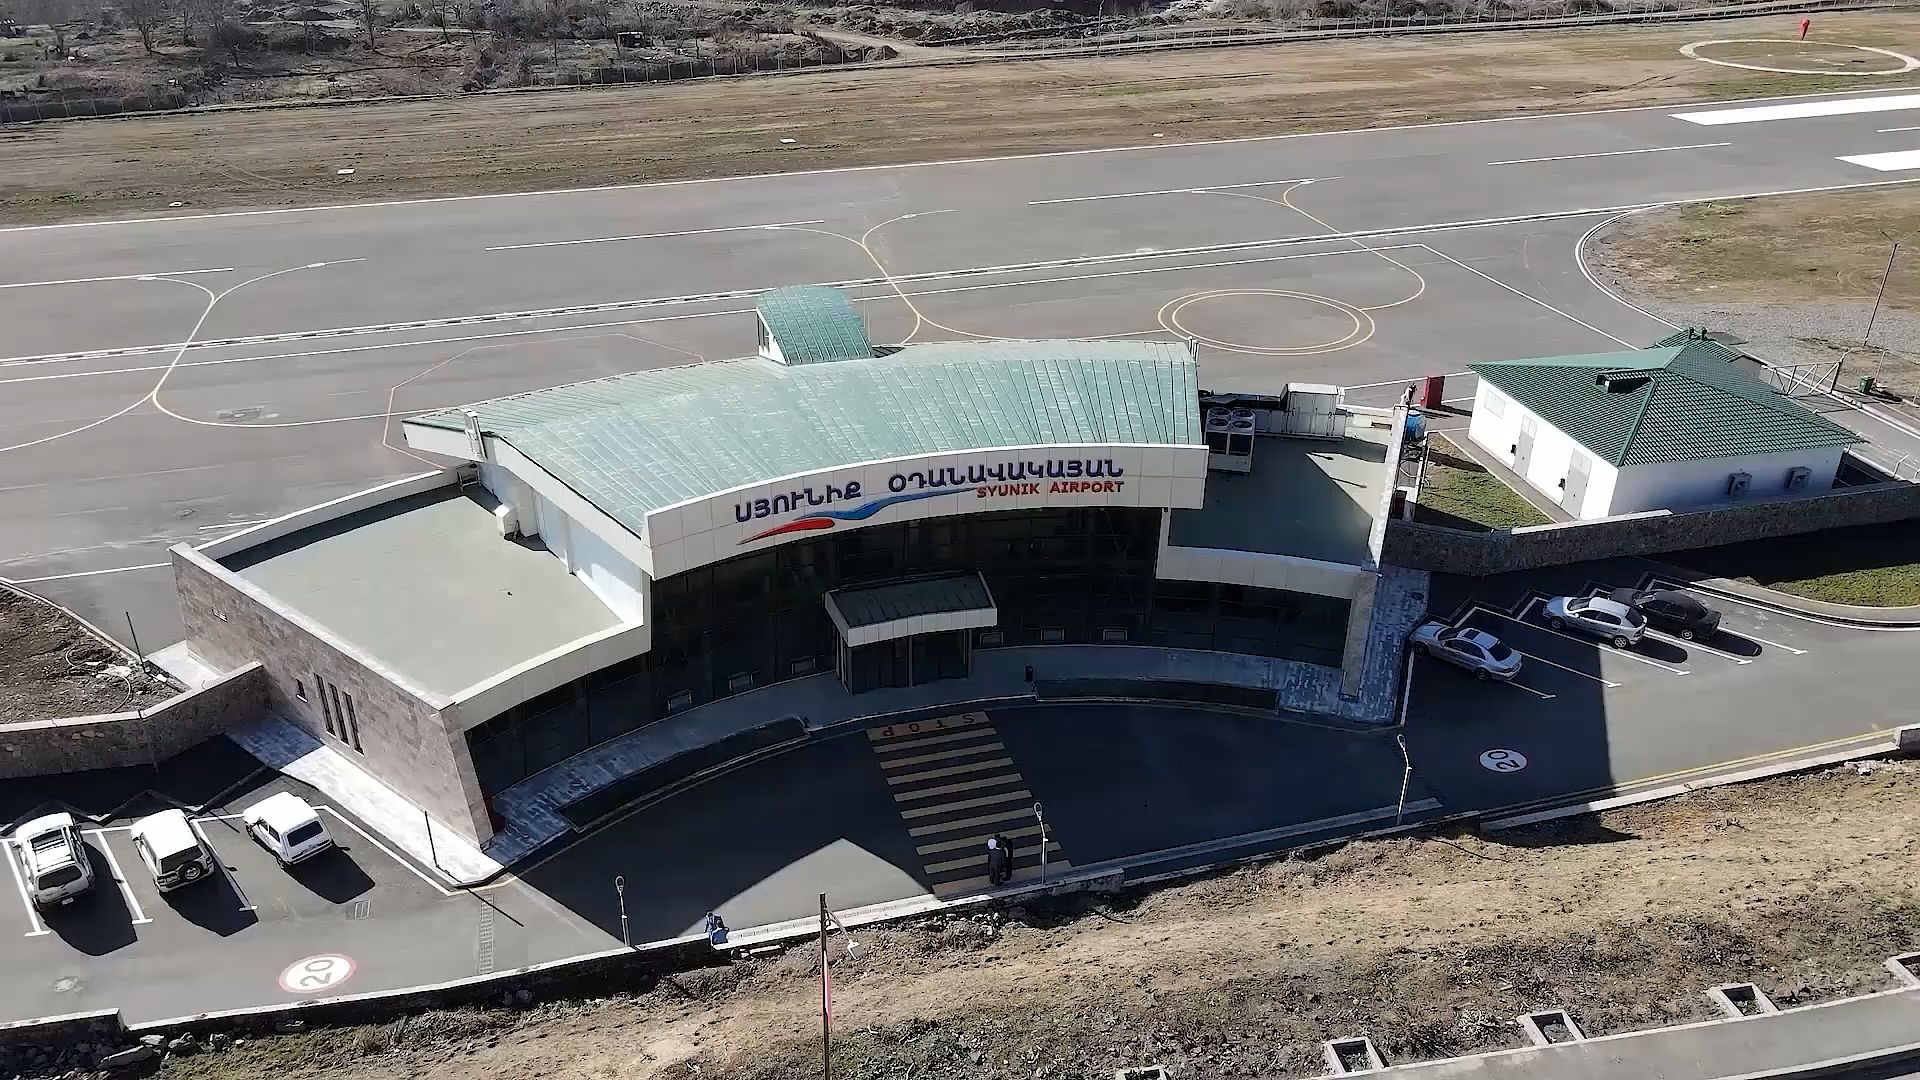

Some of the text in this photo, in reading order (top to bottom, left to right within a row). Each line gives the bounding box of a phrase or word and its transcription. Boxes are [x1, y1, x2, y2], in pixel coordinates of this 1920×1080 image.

[735, 459, 1123, 523] ՍՅՈՒՆԻՔ ՕԴԱՆԱՎԱԿԱՅԱՆ
[976, 481, 1124, 498] SYUNIK AIRPORT
[882, 714, 976, 737] STOP
[1487, 751, 1521, 770] 20
[300, 959, 335, 987] 20
